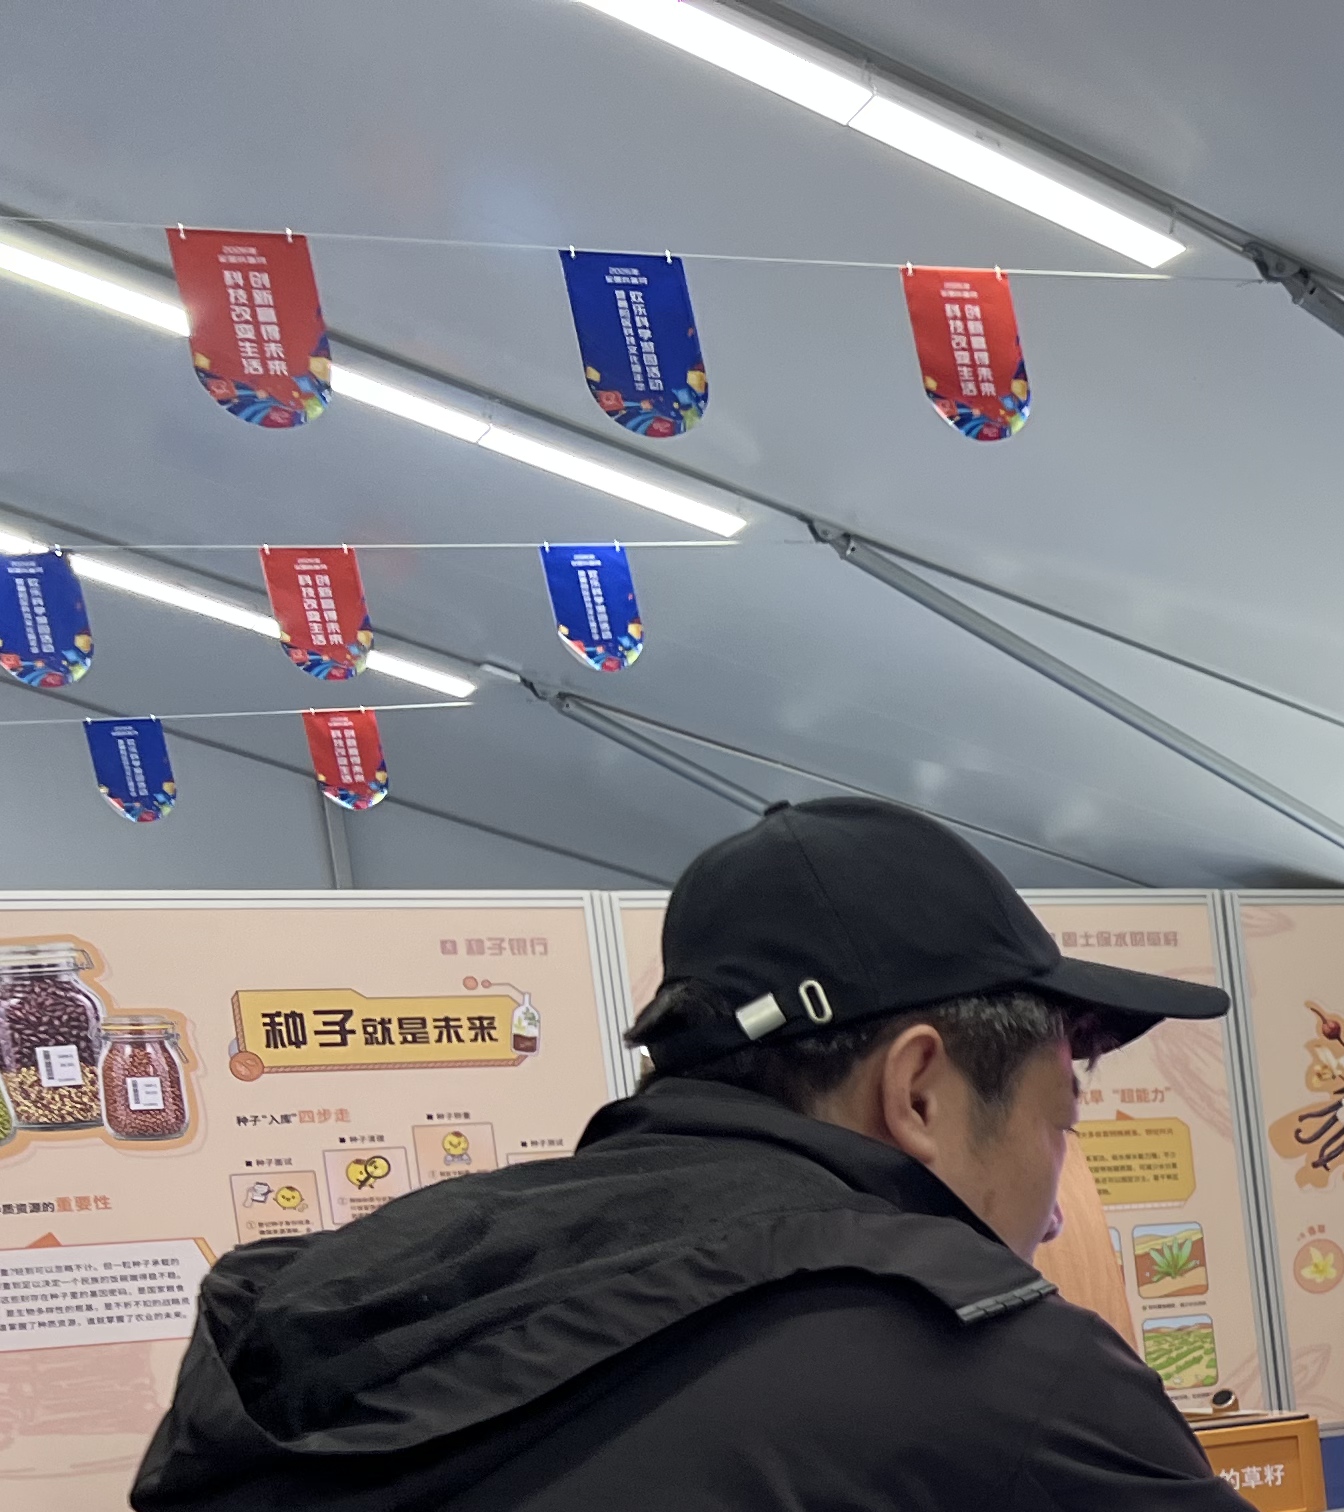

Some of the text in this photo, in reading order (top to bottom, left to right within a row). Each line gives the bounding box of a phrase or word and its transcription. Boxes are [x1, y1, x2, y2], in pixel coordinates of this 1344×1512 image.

[222, 270, 264, 375] 科技改变生活
[261, 1009, 499, 1049] 种子就是未来
[236, 1108, 351, 1127] 种子“入库”四步走
[0, 1195, 112, 1215] 质资源的重要性
[1218, 1463, 1285, 1491] 的草籽
